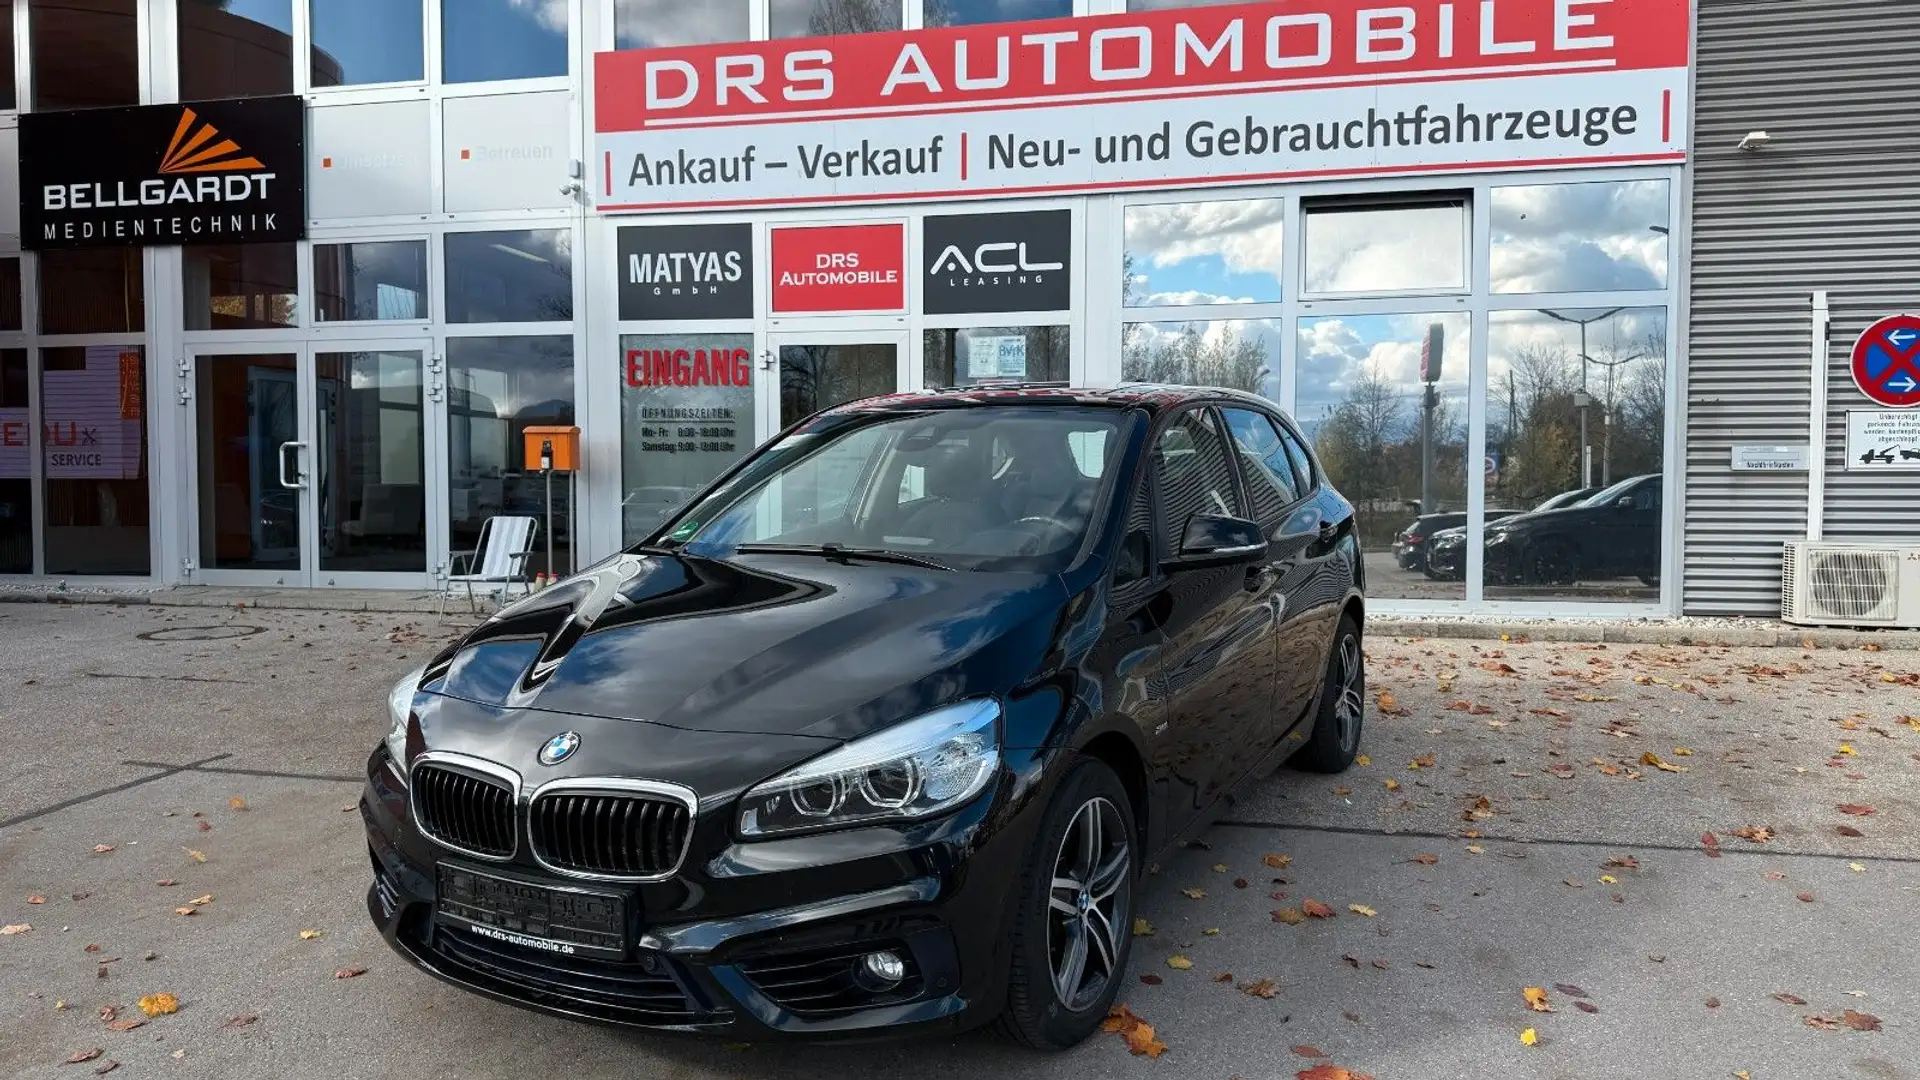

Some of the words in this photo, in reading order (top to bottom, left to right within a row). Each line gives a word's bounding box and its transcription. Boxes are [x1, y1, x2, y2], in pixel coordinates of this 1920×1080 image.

[644, 49, 834, 110] DRS
[880, 0, 1614, 96] AUTOMOBILE
[628, 145, 756, 186] Ankauf
[797, 134, 944, 179] Verkauf
[988, 133, 1081, 170] Neu-
[1095, 121, 1170, 164] und
[1185, 103, 1637, 158] Gebrauchtfahrzeuge
[44, 172, 277, 210] BELLGARDT
[44, 213, 277, 240] MEDIENTECHNIK
[629, 250, 742, 283] MATYAS
[816, 252, 859, 269] DRS
[930, 241, 1064, 275] ACL
[779, 270, 898, 286] AUTOMOBILE
[950, 275, 1042, 287] LEASING
[626, 347, 750, 388] EINGANG
[51, 453, 102, 467] SERVICE
[471, 923, 575, 955] www.drs-automobile.de
